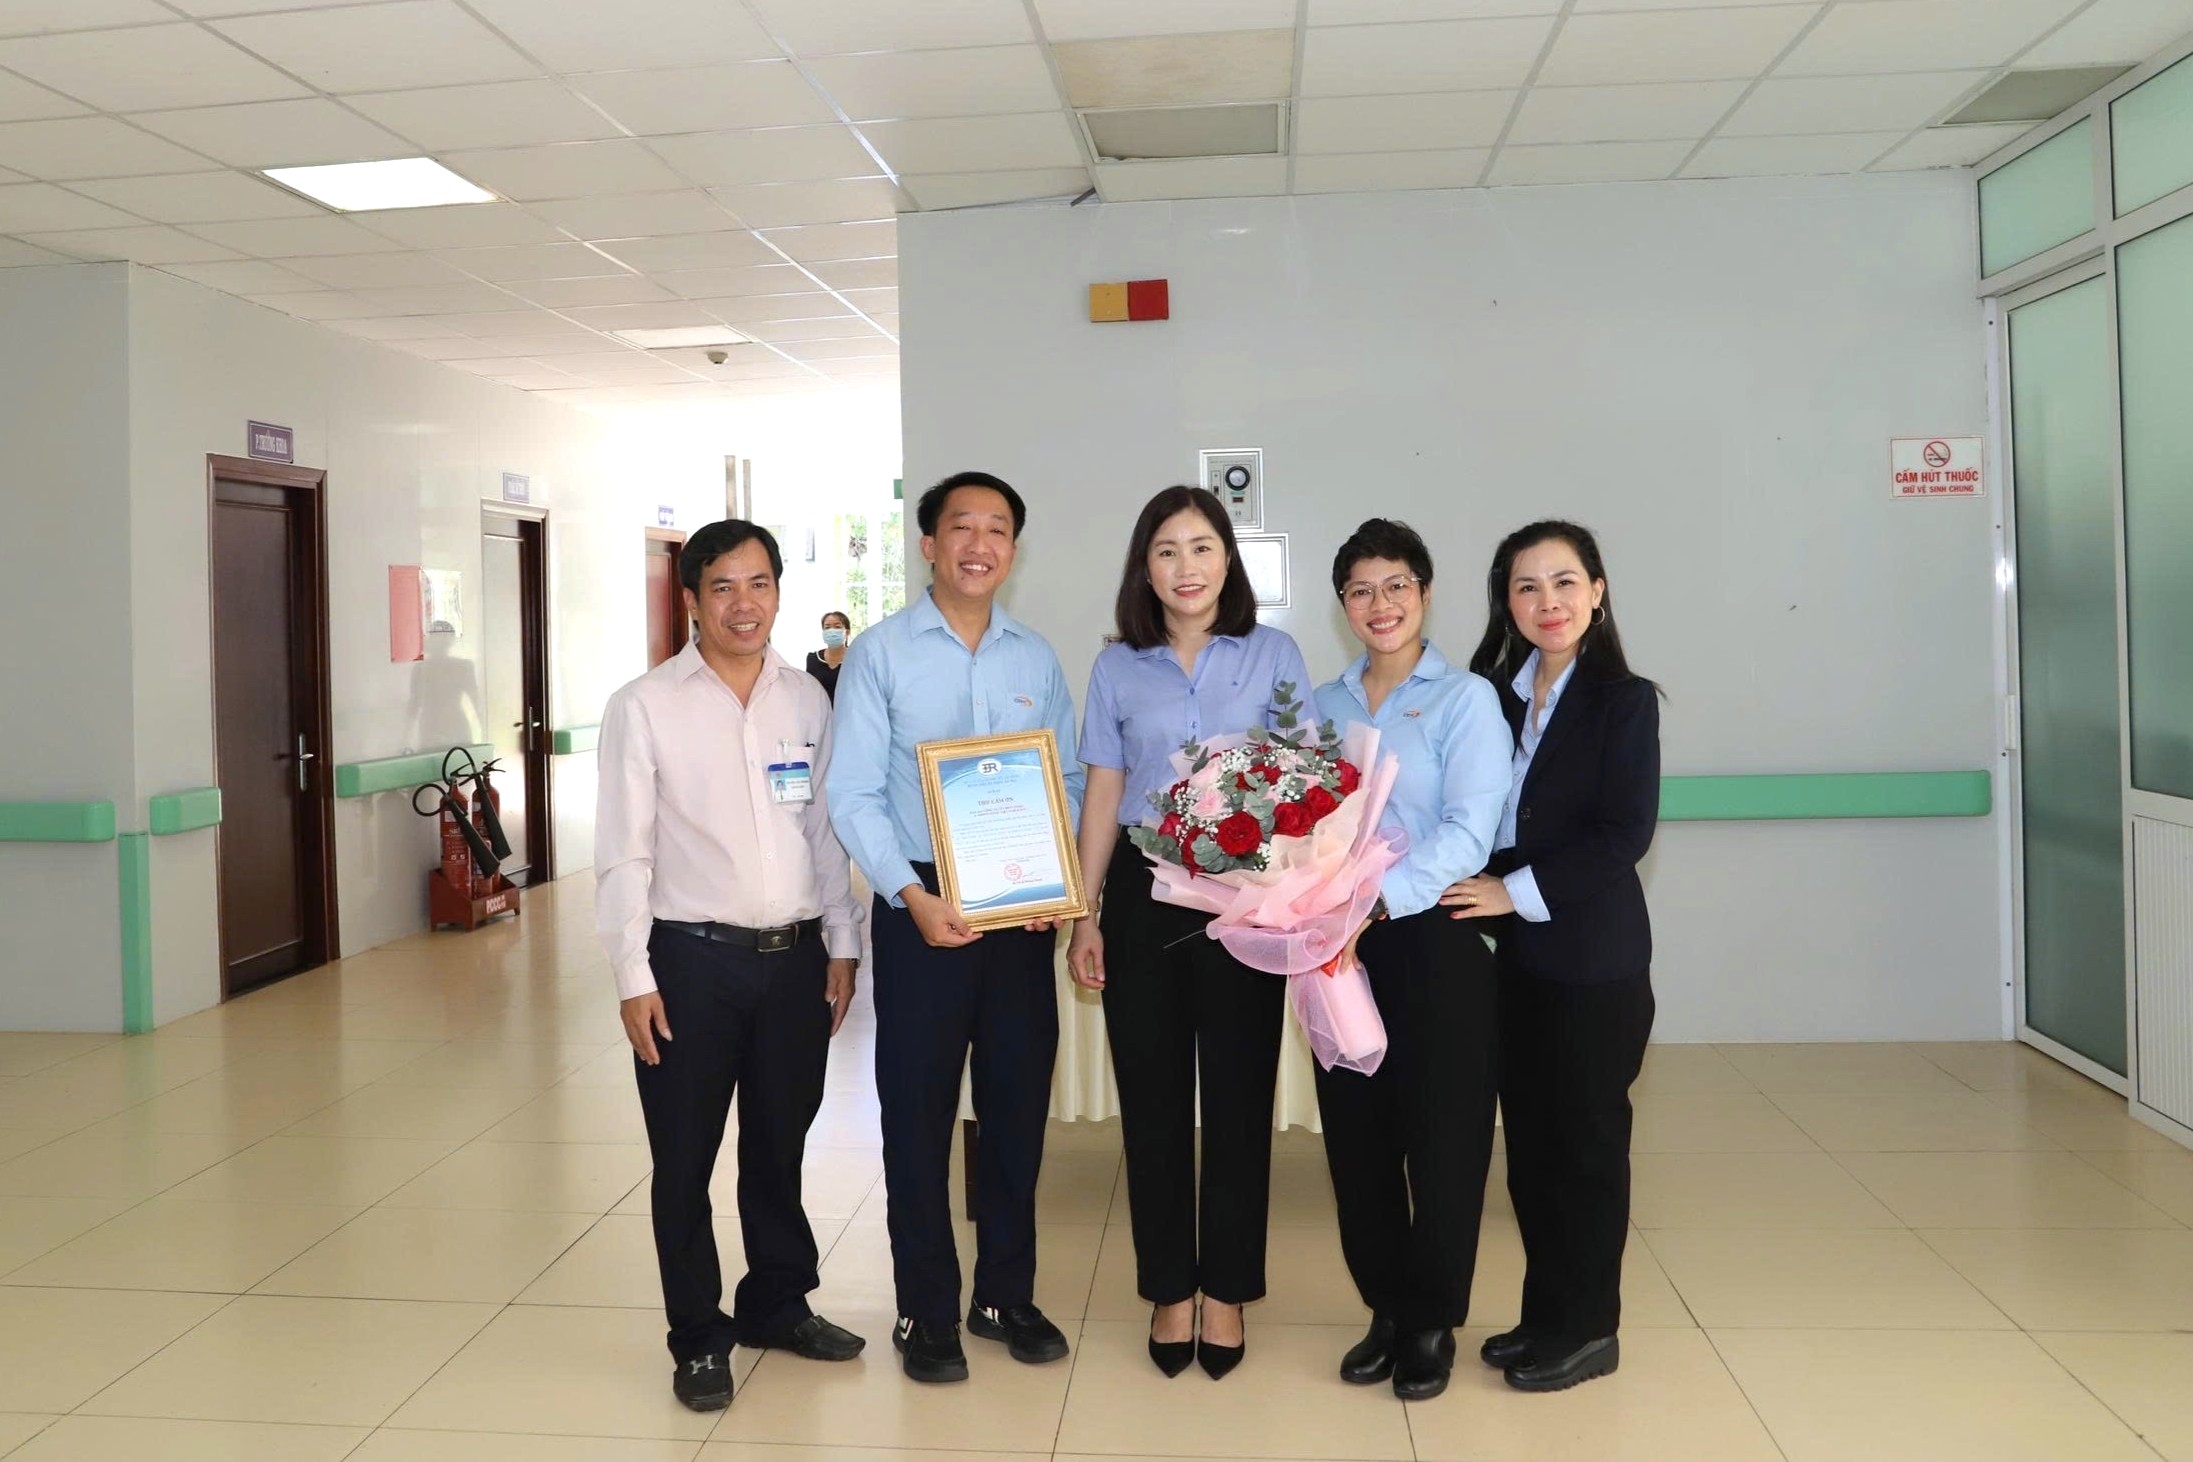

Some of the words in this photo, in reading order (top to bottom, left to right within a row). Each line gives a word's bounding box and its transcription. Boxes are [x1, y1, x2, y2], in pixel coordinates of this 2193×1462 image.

[1896, 468, 1918, 483] CẤM
[1921, 469, 1942, 482] HÚT
[1945, 467, 1979, 482] THUỐC
[1929, 485, 1946, 493] SINH
[1948, 485, 1974, 493] CHUNG
